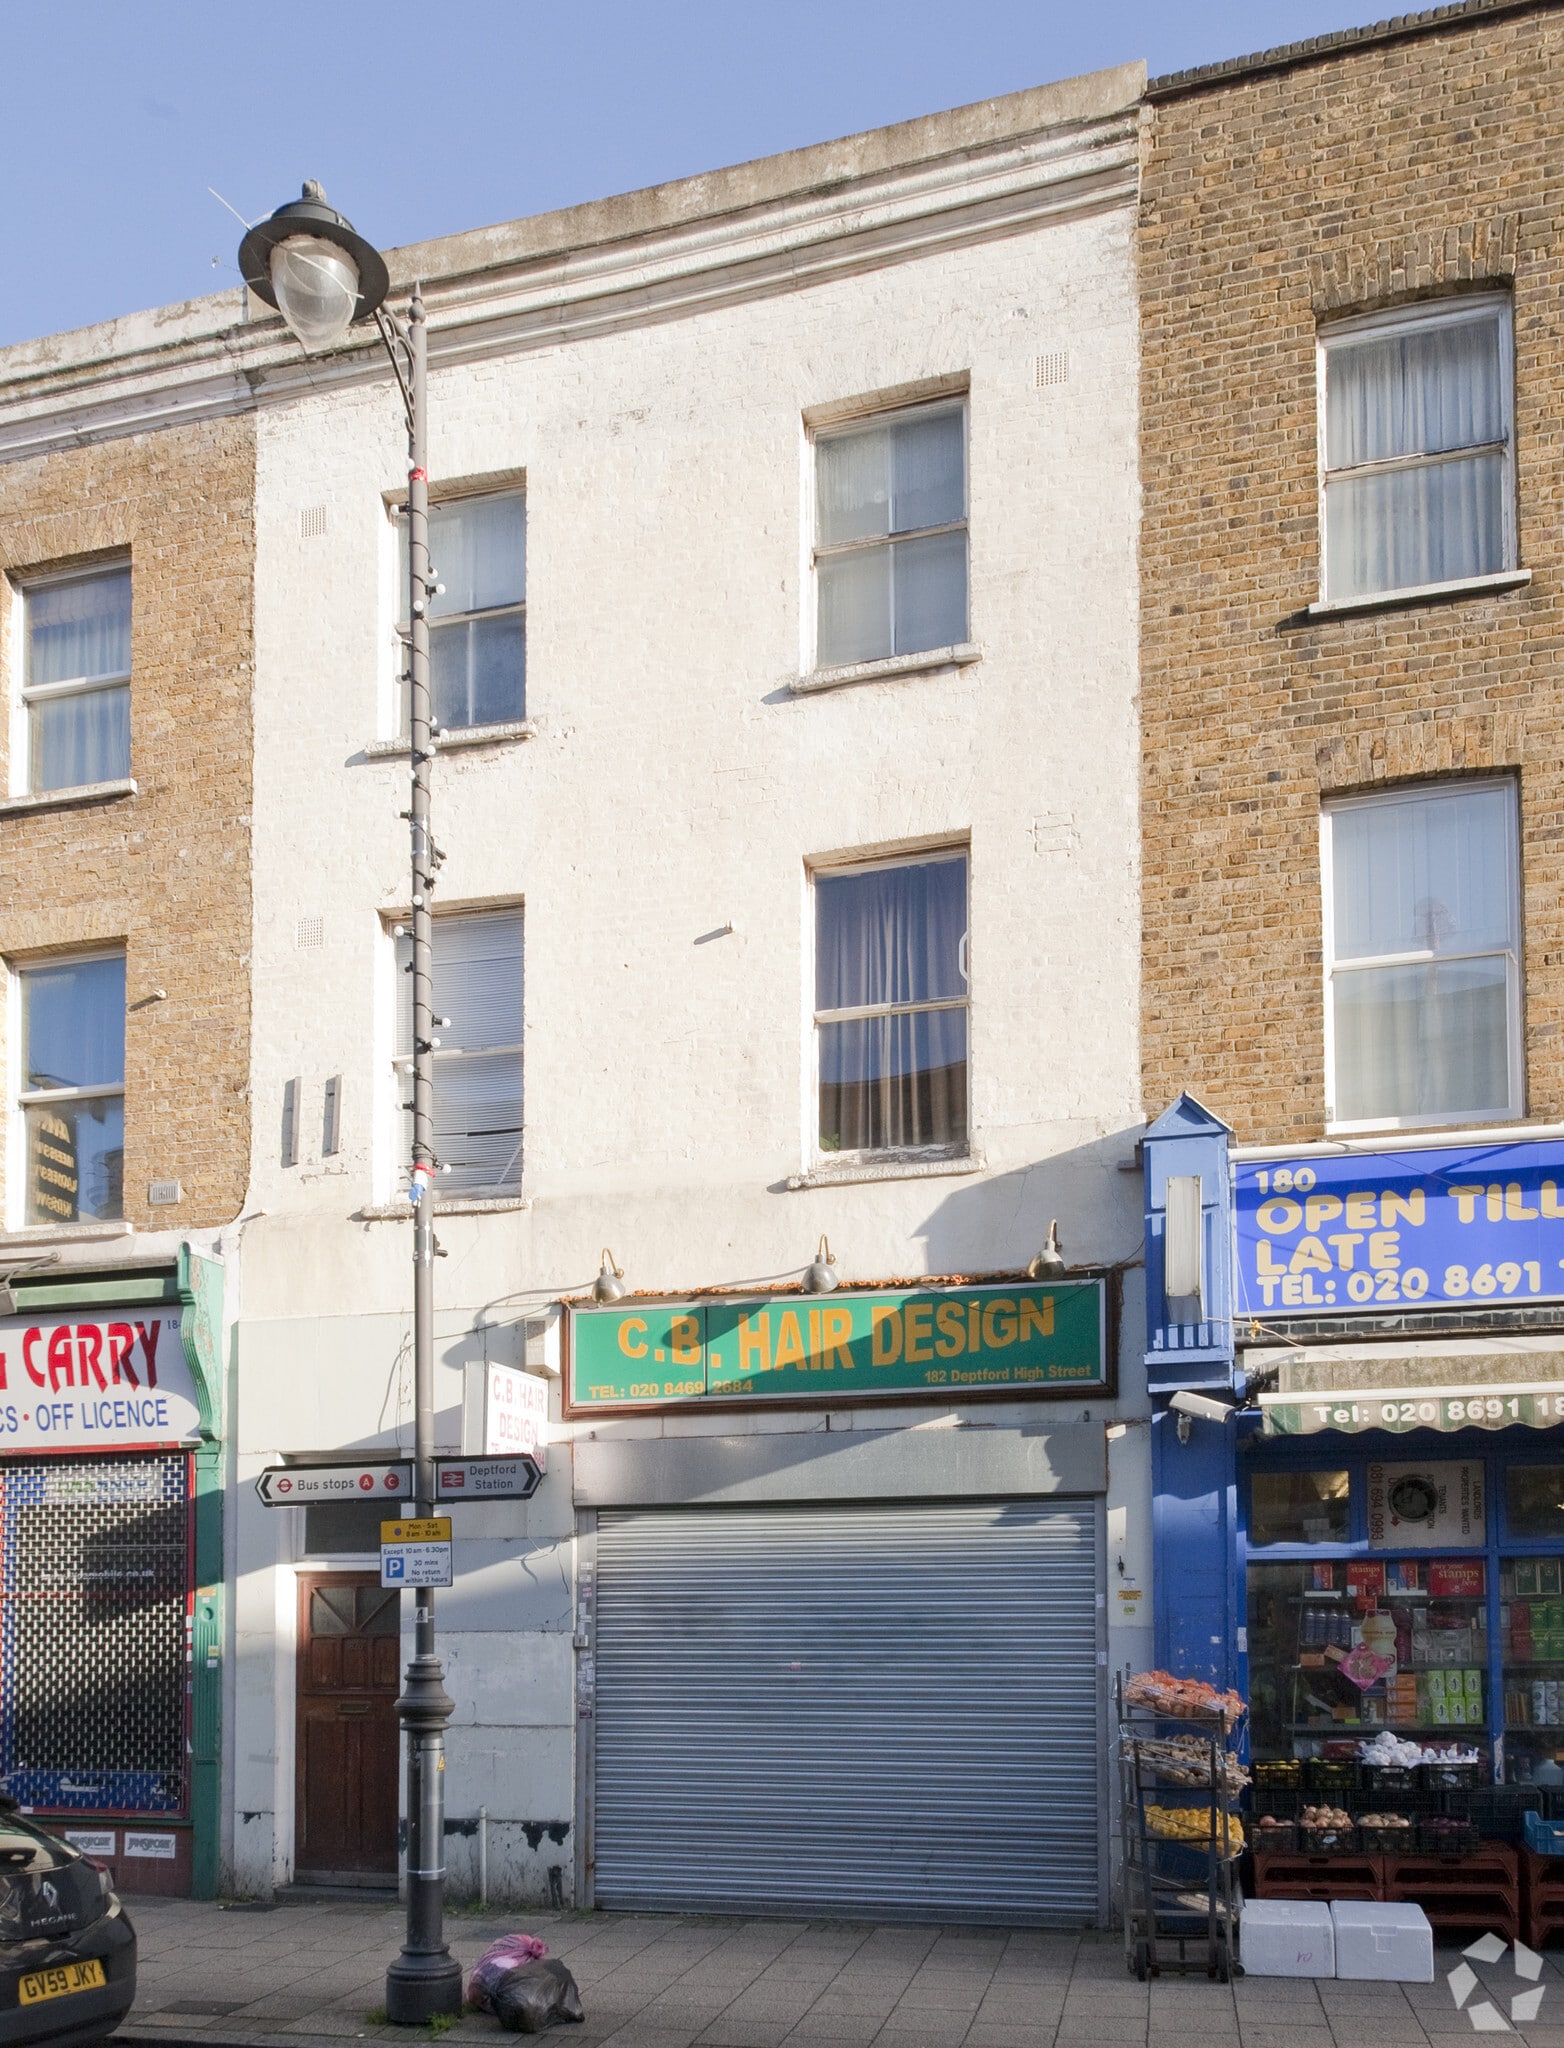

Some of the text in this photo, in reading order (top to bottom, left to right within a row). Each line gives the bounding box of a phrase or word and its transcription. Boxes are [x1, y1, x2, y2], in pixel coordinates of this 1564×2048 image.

[1255, 1168, 1317, 1195] 180
[1256, 1188, 1426, 1235] OPEN
[1256, 1231, 1401, 1276] LATE
[1256, 1261, 1541, 1307] TEL: 020 8691
[617, 1296, 1055, 1371] C.B. HAIR DESIGN
[22, 1320, 162, 1395] CARRY
[589, 1379, 754, 1399] TEL: 020 8469 2684
[924, 1364, 1092, 1384] 182 Deptford High Street
[520, 1382, 545, 1414] HAIR
[1313, 1404, 1370, 1423] Tel:
[1381, 1402, 1436, 1422] 020
[1447, 1398, 1519, 1421] 8691
[36, 1402, 74, 1431] OFF
[81, 1398, 169, 1430] LICENCE
[499, 1412, 539, 1447] DESIGN
[297, 1479, 320, 1491] Bus
[323, 1477, 355, 1492] stops
[469, 1464, 517, 1477] Deptford
[475, 1479, 514, 1490] Station
[1439, 1485, 1447, 1515] TENANTS
[1461, 1467, 1471, 1535] PROPERTIES WANTED
[1473, 1480, 1482, 1520] LANDLORDS
[383, 1548, 404, 1556] Except
[389, 1559, 401, 1576] P
[1438, 1568, 1480, 1581] stamps
[24, 1962, 97, 1998] GV59 JKY
